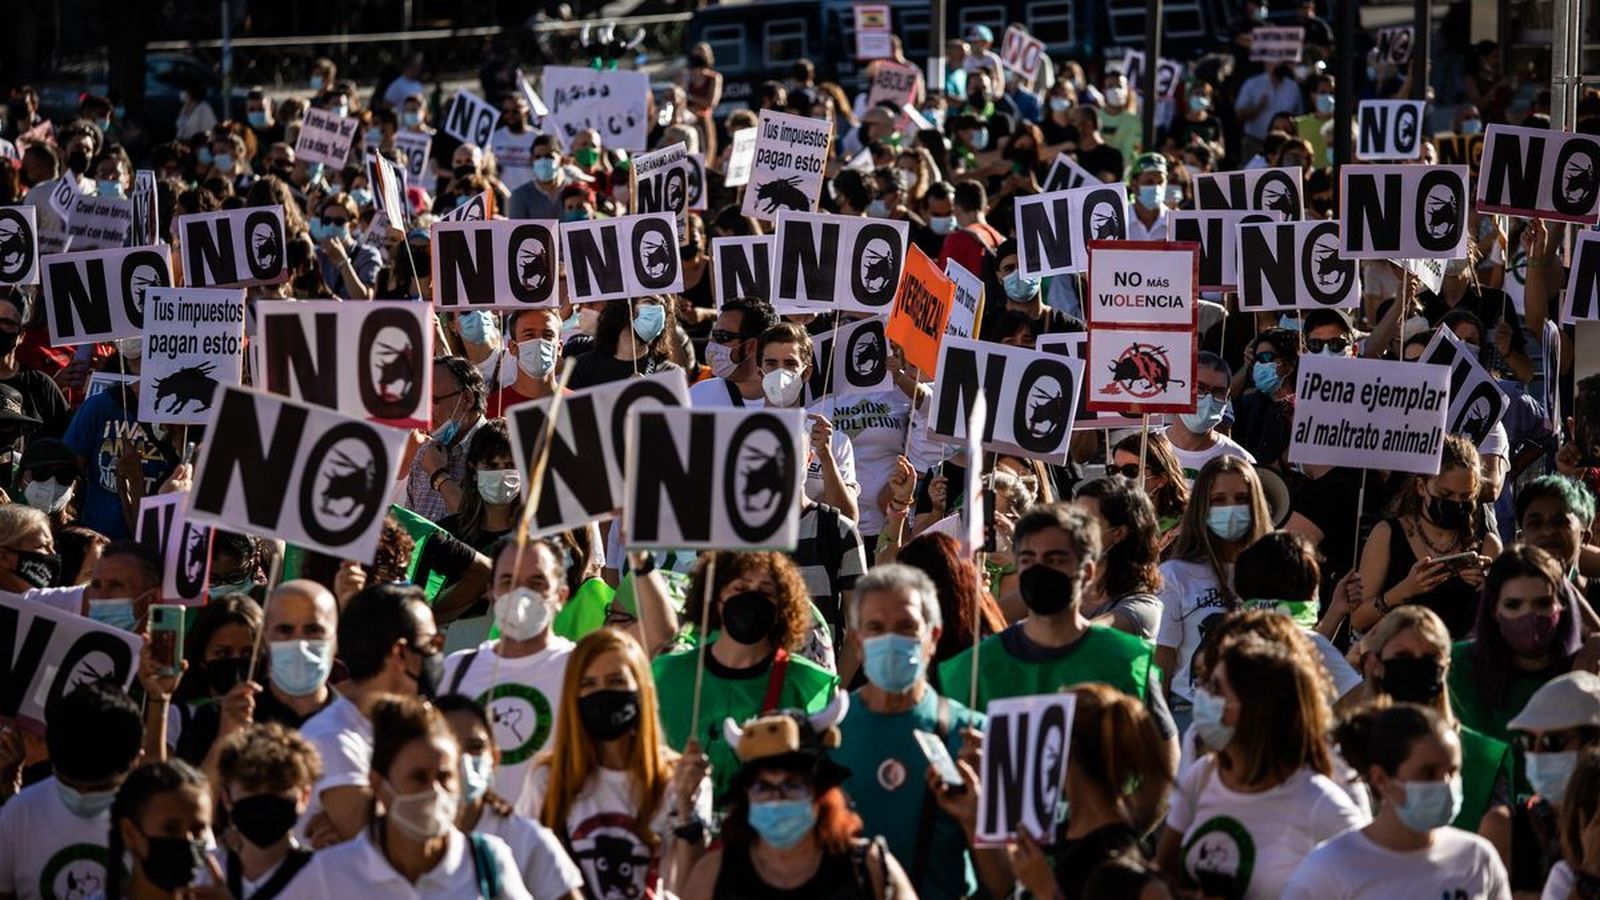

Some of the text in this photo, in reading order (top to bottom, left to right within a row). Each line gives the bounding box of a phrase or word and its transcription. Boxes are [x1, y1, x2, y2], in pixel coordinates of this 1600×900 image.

[451, 94, 494, 148] NO
[763, 118, 828, 148] Tus impuestos
[1361, 104, 1418, 154] NO
[638, 166, 687, 215] NO
[756, 148, 792, 171] pagan
[795, 153, 825, 174] esto:
[1197, 170, 1300, 220] NO
[1486, 133, 1600, 215] NO
[0, 209, 34, 283] O
[76, 200, 96, 214] Cruel
[96, 205, 110, 217] con
[88, 227, 102, 240] con
[1021, 188, 1123, 274] NO
[1348, 169, 1464, 251] NO
[186, 211, 283, 288] NO
[438, 224, 555, 306] NO
[568, 217, 678, 297] NO
[719, 243, 772, 301] N
[780, 220, 901, 307] NO
[1114, 272, 1170, 289] NO MÁS
[1241, 222, 1356, 307] NO
[48, 250, 170, 338] NO
[153, 295, 244, 326] Tus impuestos
[1098, 294, 1184, 309] VIOLENCIA
[149, 332, 242, 360] pagan esto:
[265, 307, 424, 419] NO
[808, 319, 887, 400] NO
[936, 346, 1074, 453] NO
[1301, 372, 1446, 414] ¡Pena ejemplar
[1427, 335, 1501, 448] NO
[194, 387, 389, 546] NO
[1295, 419, 1442, 456] al maltrato animal!
[634, 412, 796, 543] NO
[139, 503, 211, 599] NO
[986, 704, 1065, 834] NO
